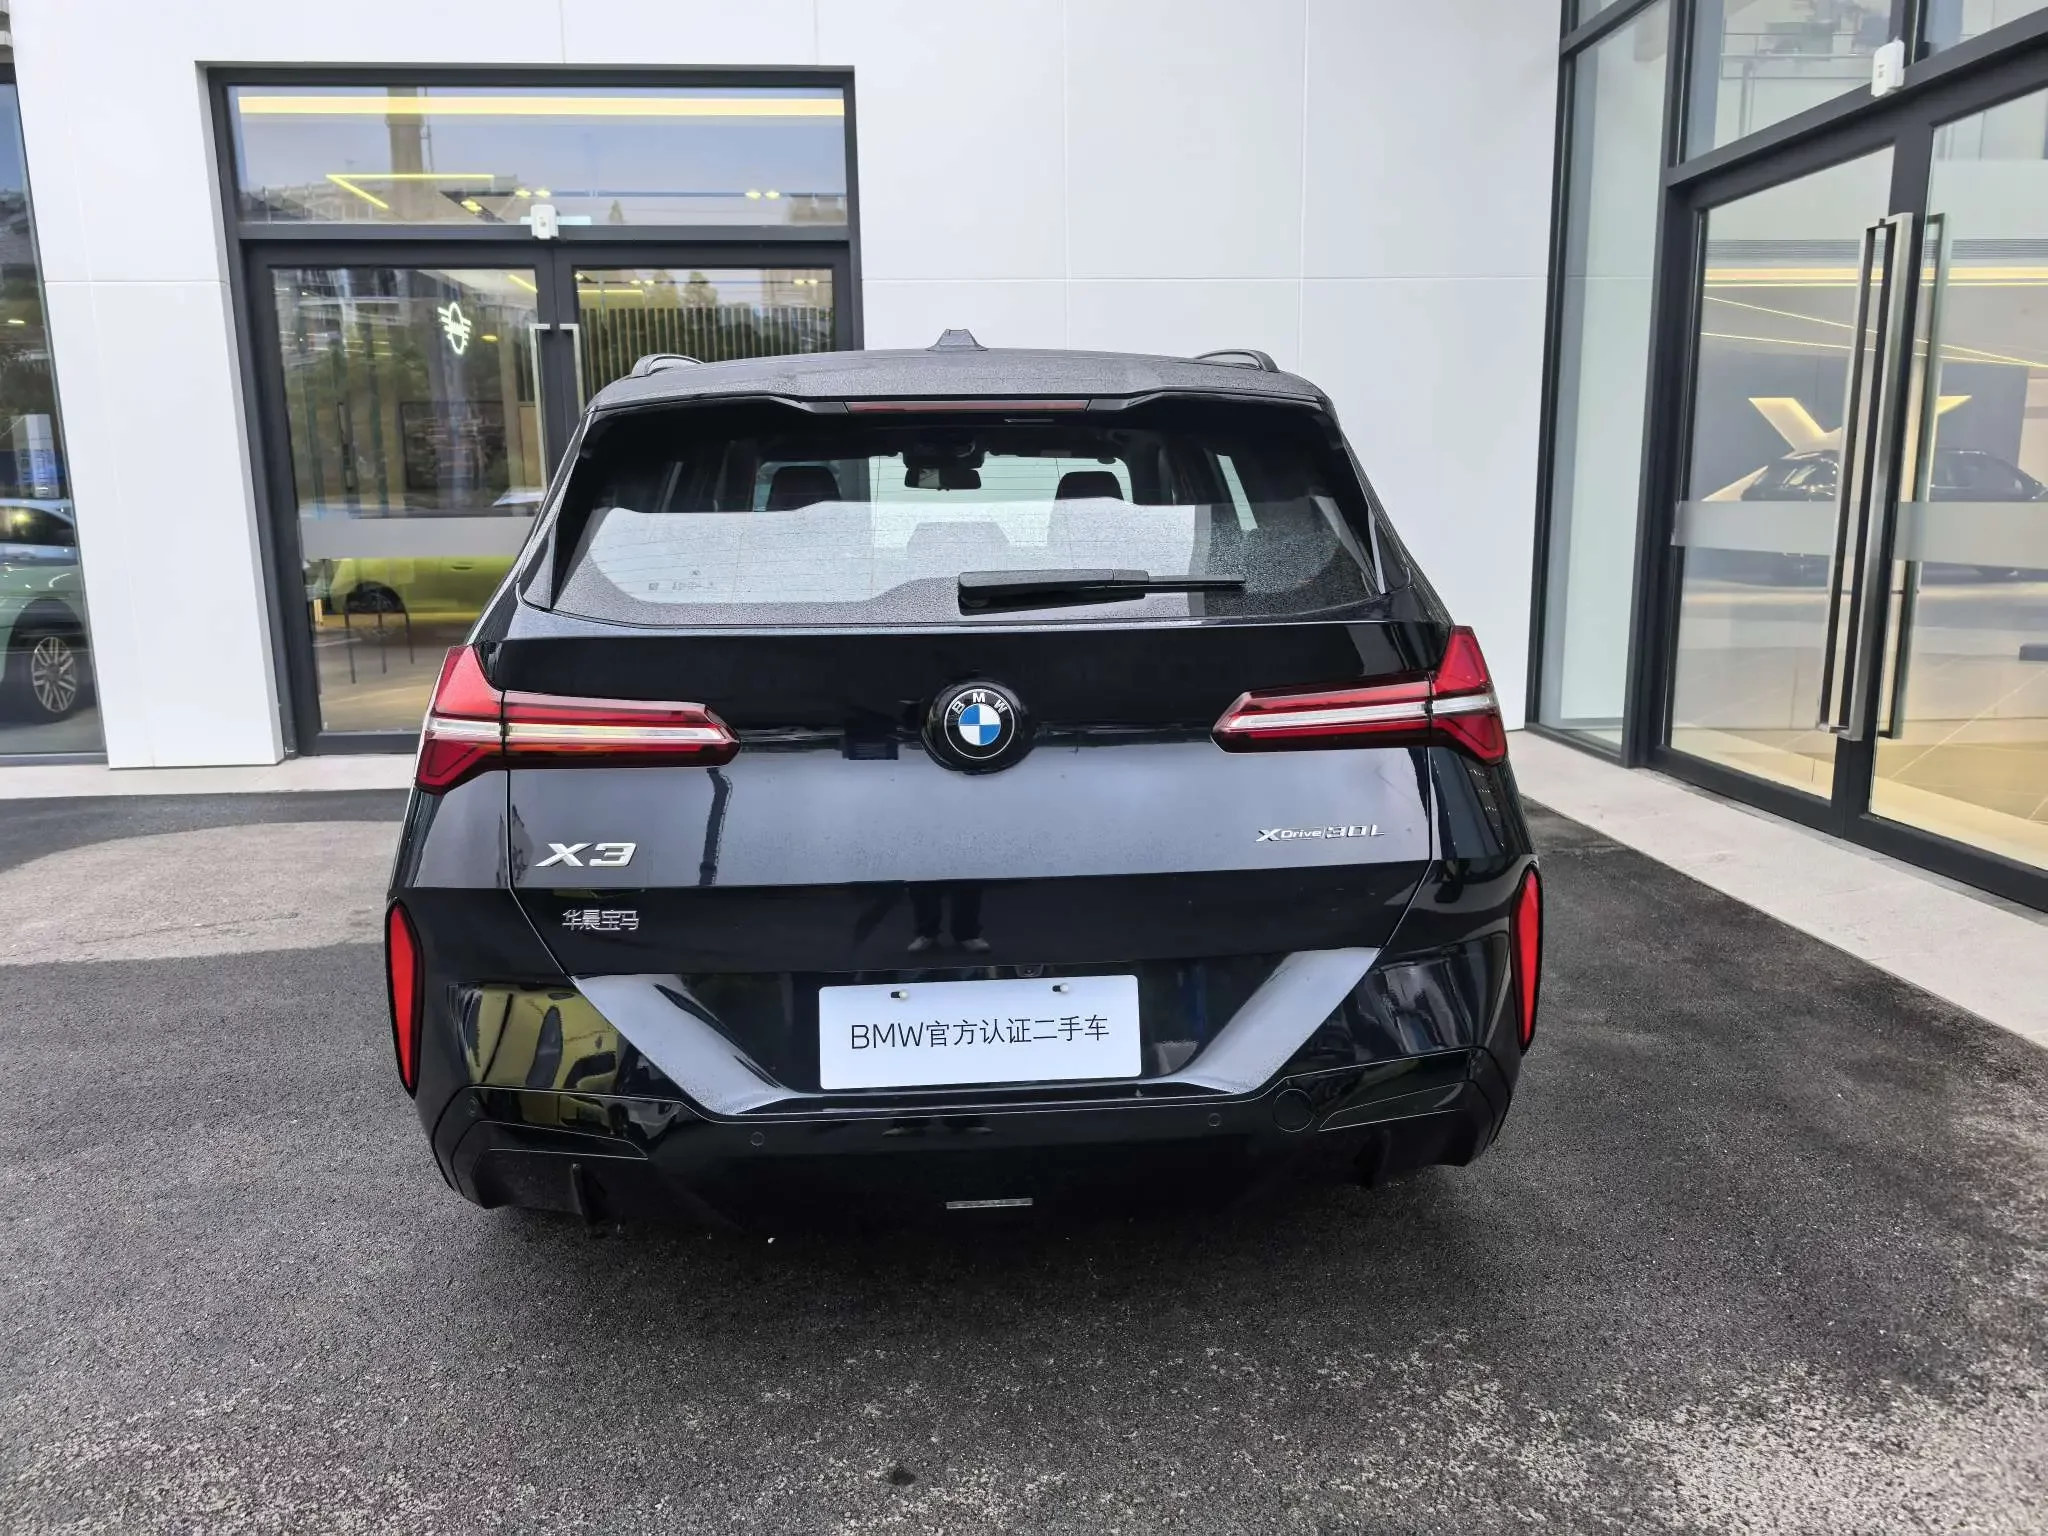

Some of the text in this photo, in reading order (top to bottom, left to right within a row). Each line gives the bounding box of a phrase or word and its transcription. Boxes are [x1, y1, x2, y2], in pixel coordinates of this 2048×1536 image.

[951, 692, 1008, 715] BMW
[535, 842, 638, 867] X3
[562, 909, 640, 931] 华晨宝马
[850, 1013, 1110, 1050] BMW官方认证二手车
